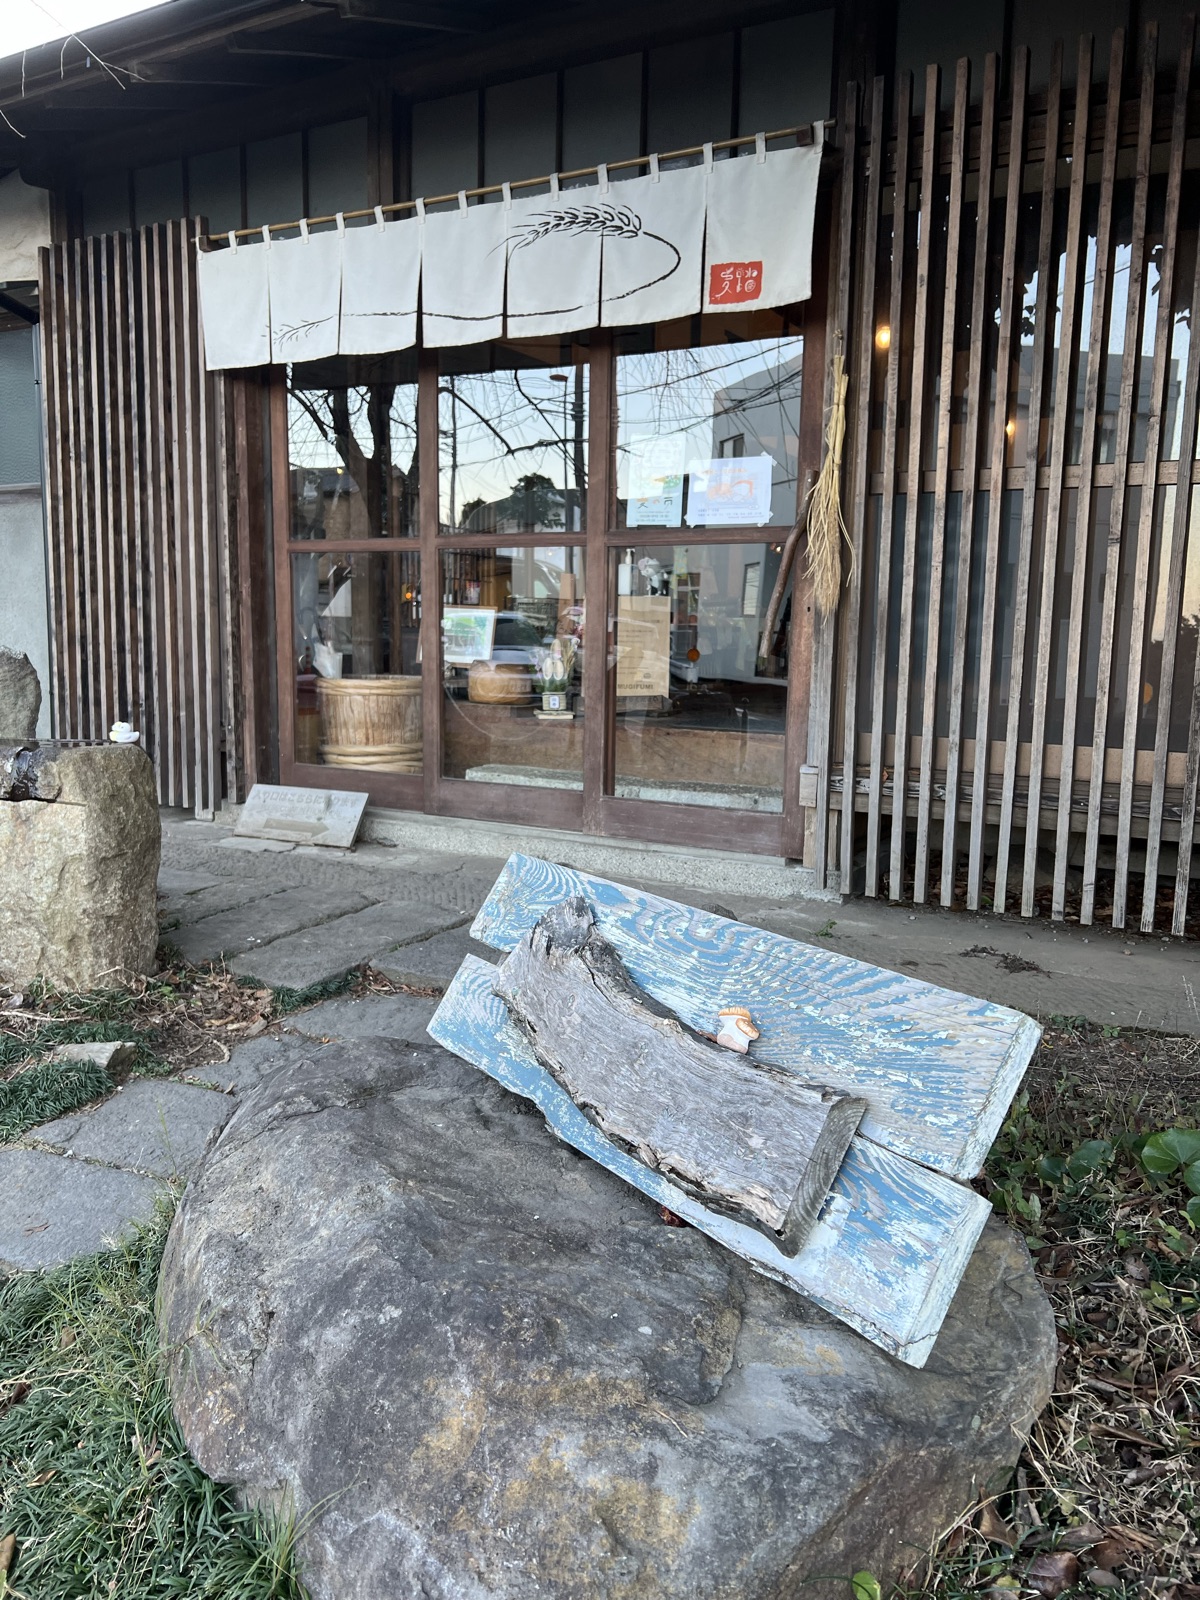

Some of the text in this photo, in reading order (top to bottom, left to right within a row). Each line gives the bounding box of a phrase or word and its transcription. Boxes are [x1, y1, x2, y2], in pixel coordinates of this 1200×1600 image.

[252, 791, 358, 808] 入り口はこちらにります
